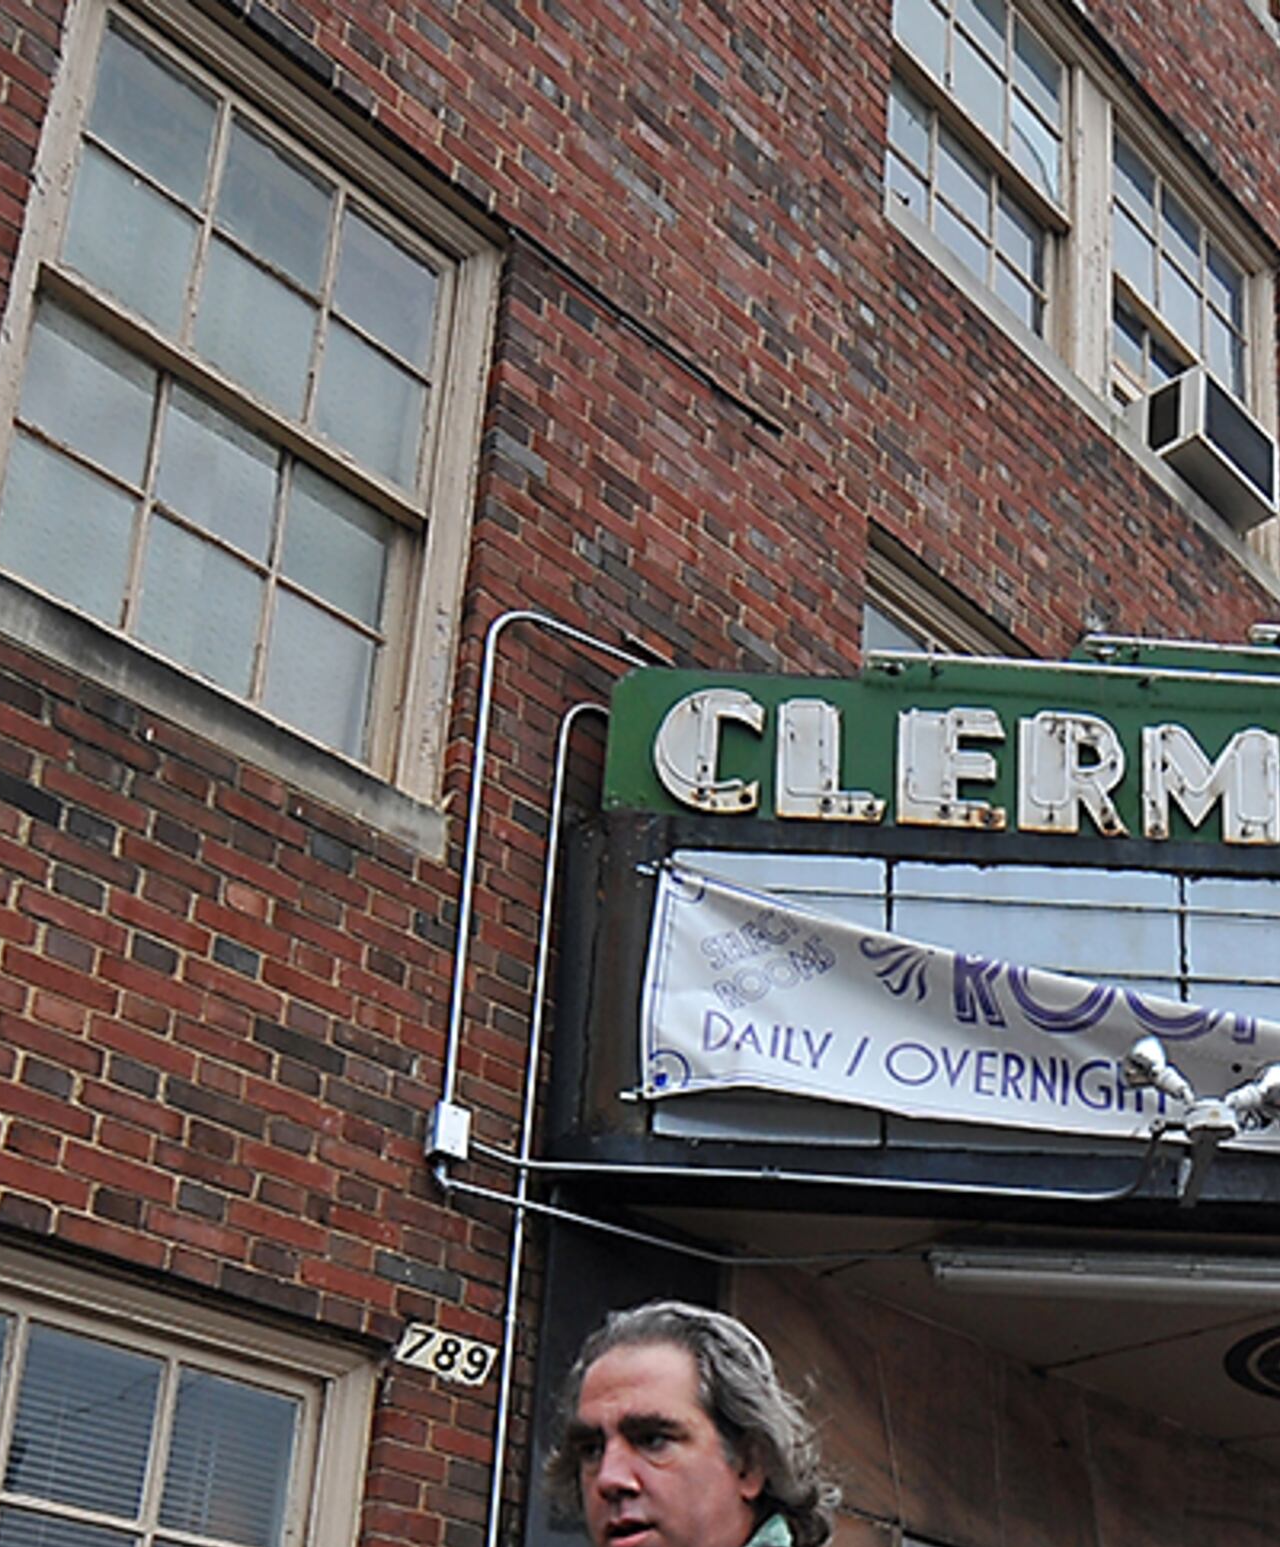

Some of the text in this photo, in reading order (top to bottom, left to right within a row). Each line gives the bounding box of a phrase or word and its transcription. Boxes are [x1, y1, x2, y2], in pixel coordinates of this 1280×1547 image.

[713, 935, 836, 1009] ROOMS
[703, 1009, 832, 1069] DAILY
[403, 1328, 488, 1381] 789
